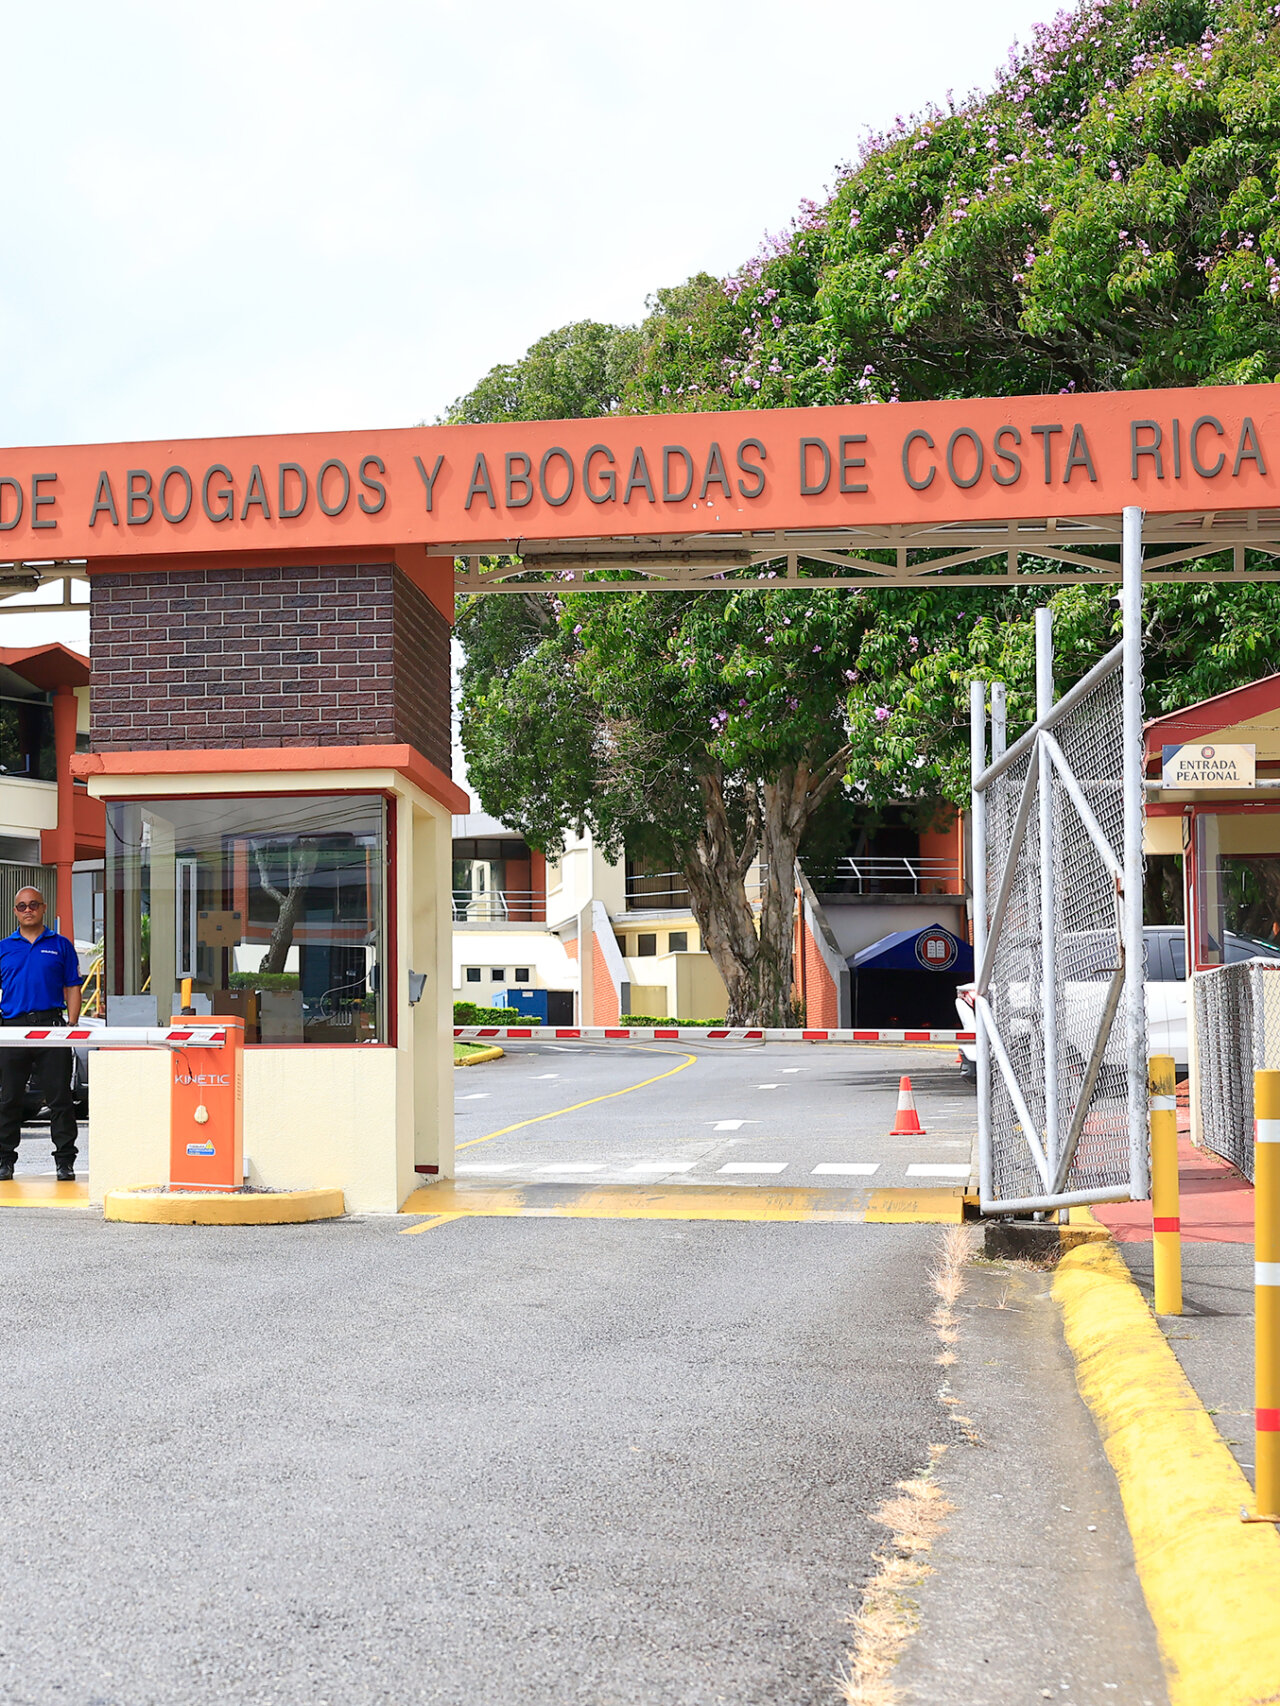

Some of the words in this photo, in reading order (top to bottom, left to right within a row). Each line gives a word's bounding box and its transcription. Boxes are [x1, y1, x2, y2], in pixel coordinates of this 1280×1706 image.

[89, 454, 387, 527] ABOGADOS
[413, 454, 446, 513] Y
[464, 437, 768, 511] ABOGADAS
[799, 434, 869, 497] DE
[901, 423, 1098, 491] COSTA
[1130, 414, 1268, 480] RICA
[1179, 760, 1237, 770] ENTRADA
[1176, 771, 1240, 781] PEATONAL
[174, 1074, 230, 1085] KINETIC
